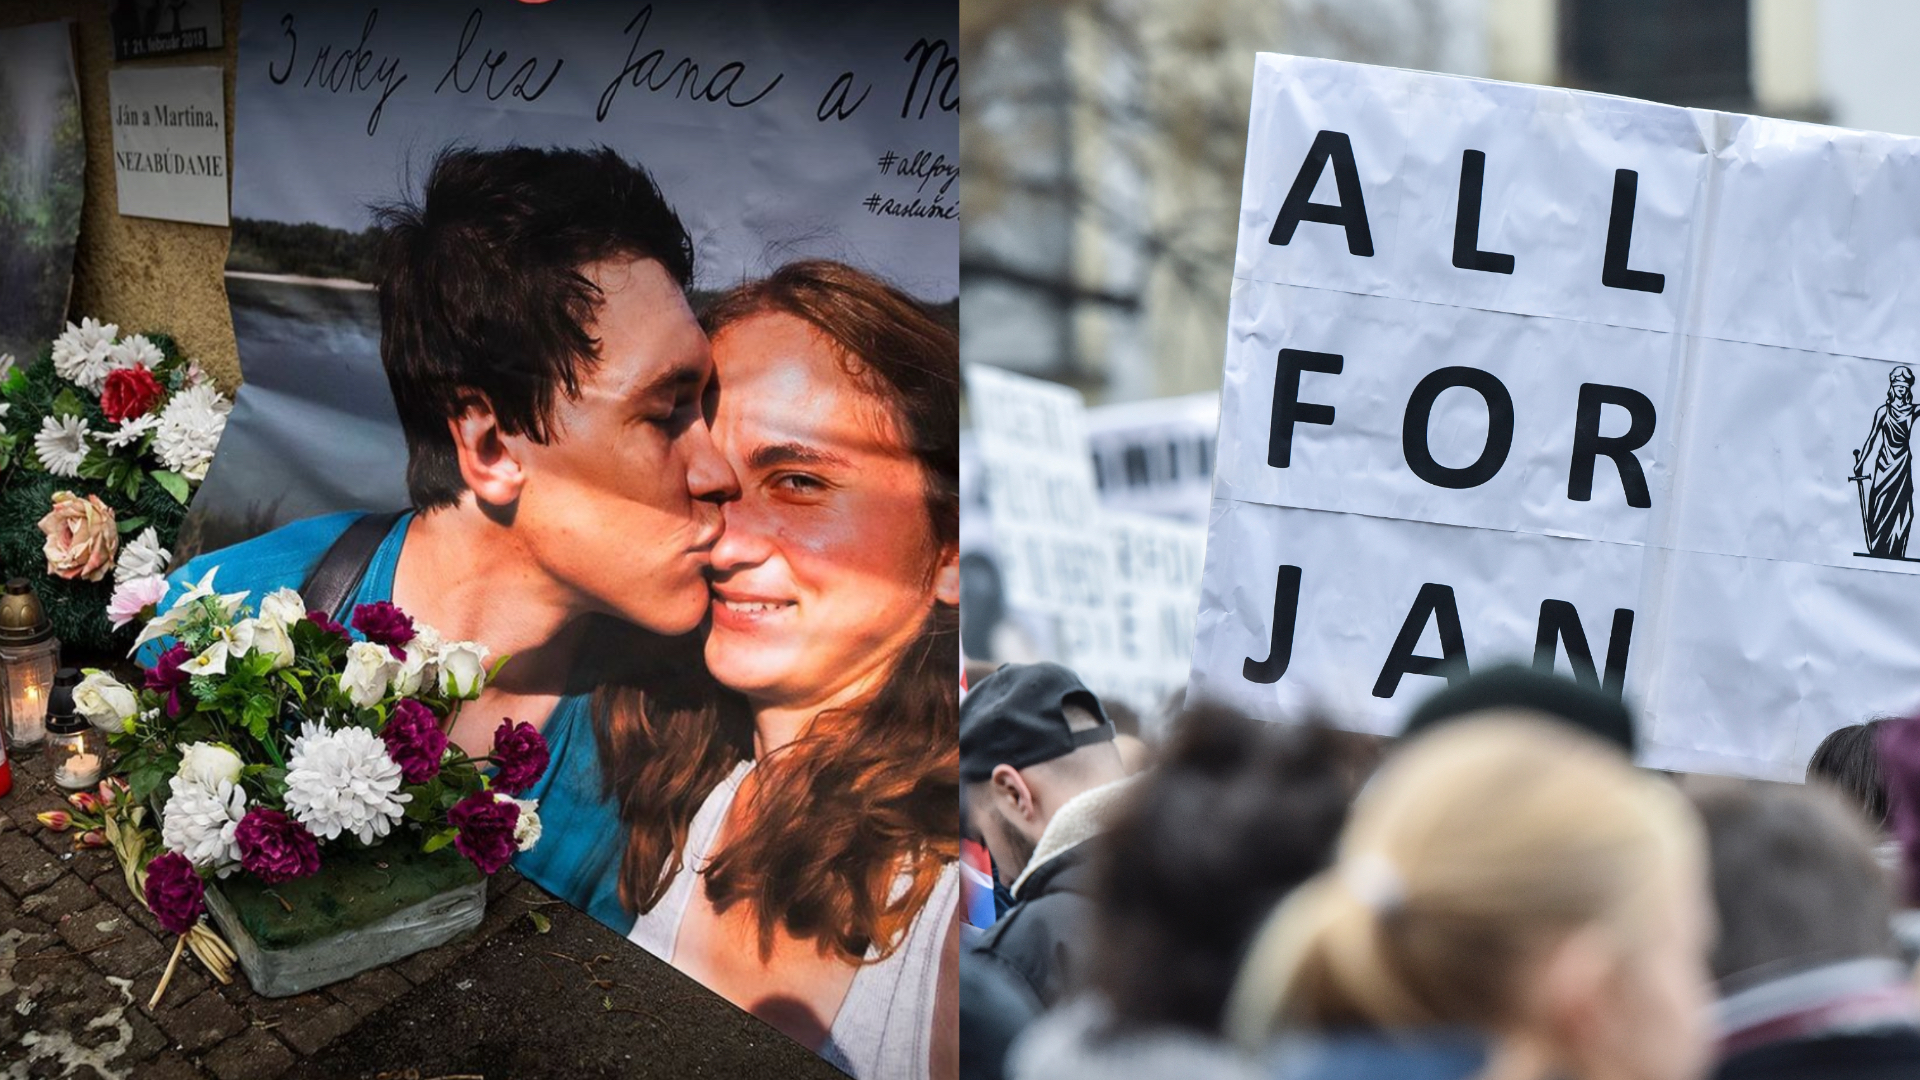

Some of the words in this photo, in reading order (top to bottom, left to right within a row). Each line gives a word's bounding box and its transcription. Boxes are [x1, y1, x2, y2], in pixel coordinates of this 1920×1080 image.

[116, 104, 139, 126] Ján
[142, 110, 151, 126] a
[154, 104, 219, 131] Martina,
[269, 13, 297, 84] 3
[304, 8, 407, 136] roky
[435, 8, 564, 101] bez
[597, 4, 784, 122] Jana
[817, 71, 873, 121] a
[117, 147, 223, 177] NEZABÚDAME
[1268, 129, 1666, 294] ALL
[1267, 348, 1657, 509] FOR
[1243, 564, 1635, 701] JAN
